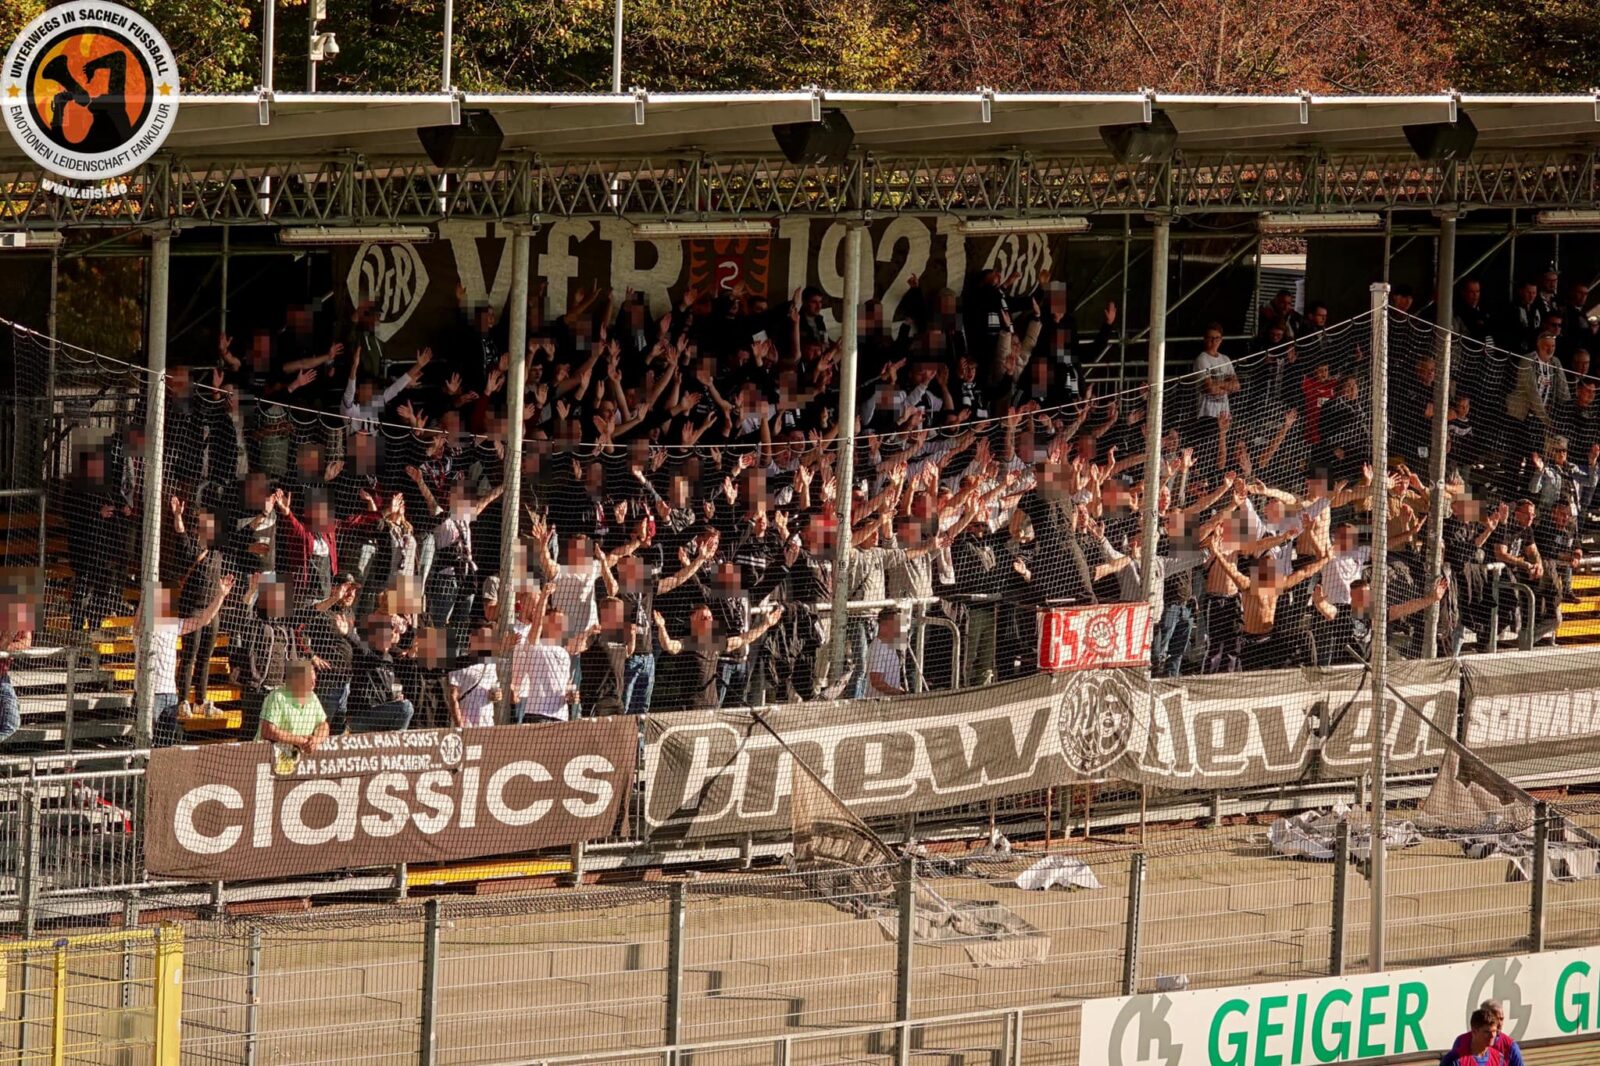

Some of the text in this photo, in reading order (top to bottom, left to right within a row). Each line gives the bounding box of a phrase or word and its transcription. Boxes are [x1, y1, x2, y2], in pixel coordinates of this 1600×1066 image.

[438, 215, 968, 341] VfR 1921
[297, 759, 317, 776] AM
[320, 756, 379, 775] SAMSTAG
[341, 735, 373, 751] SOLL
[374, 733, 400, 748] MAN
[403, 731, 440, 747] SONST
[644, 705, 1054, 827] Crew
[173, 745, 615, 855] classics
[1208, 981, 1429, 1066] GEIGER
[1554, 960, 1600, 1034] G
